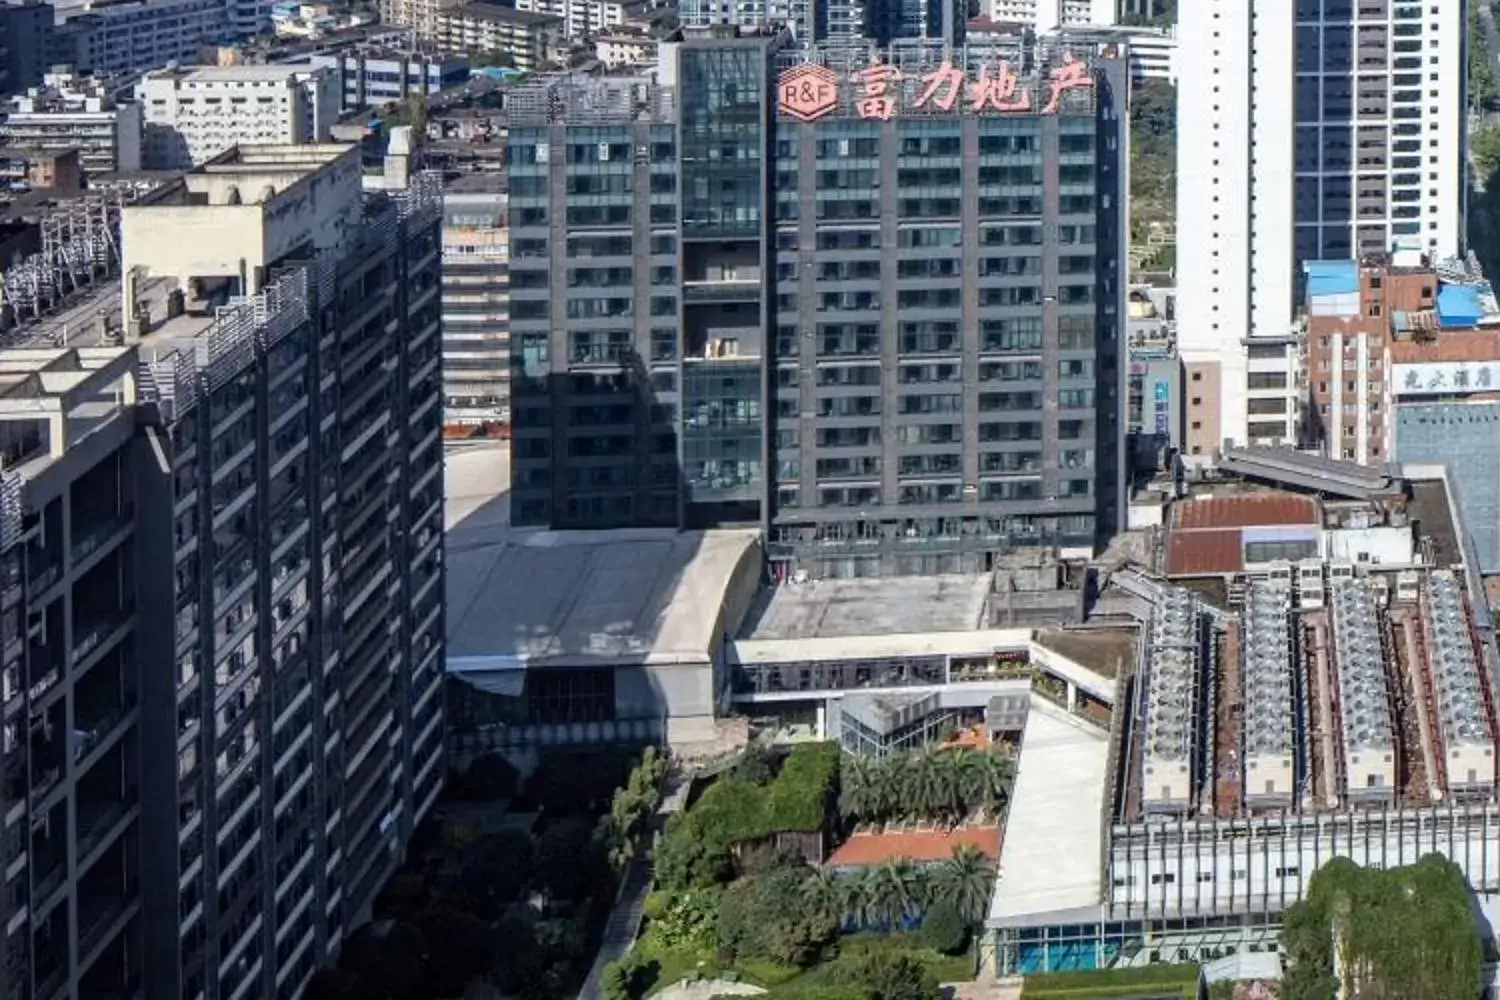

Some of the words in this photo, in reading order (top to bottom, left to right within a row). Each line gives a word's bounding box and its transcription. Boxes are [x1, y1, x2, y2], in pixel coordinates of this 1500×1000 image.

[785, 81, 829, 103] R&F
[850, 51, 1093, 120] 富力地产
